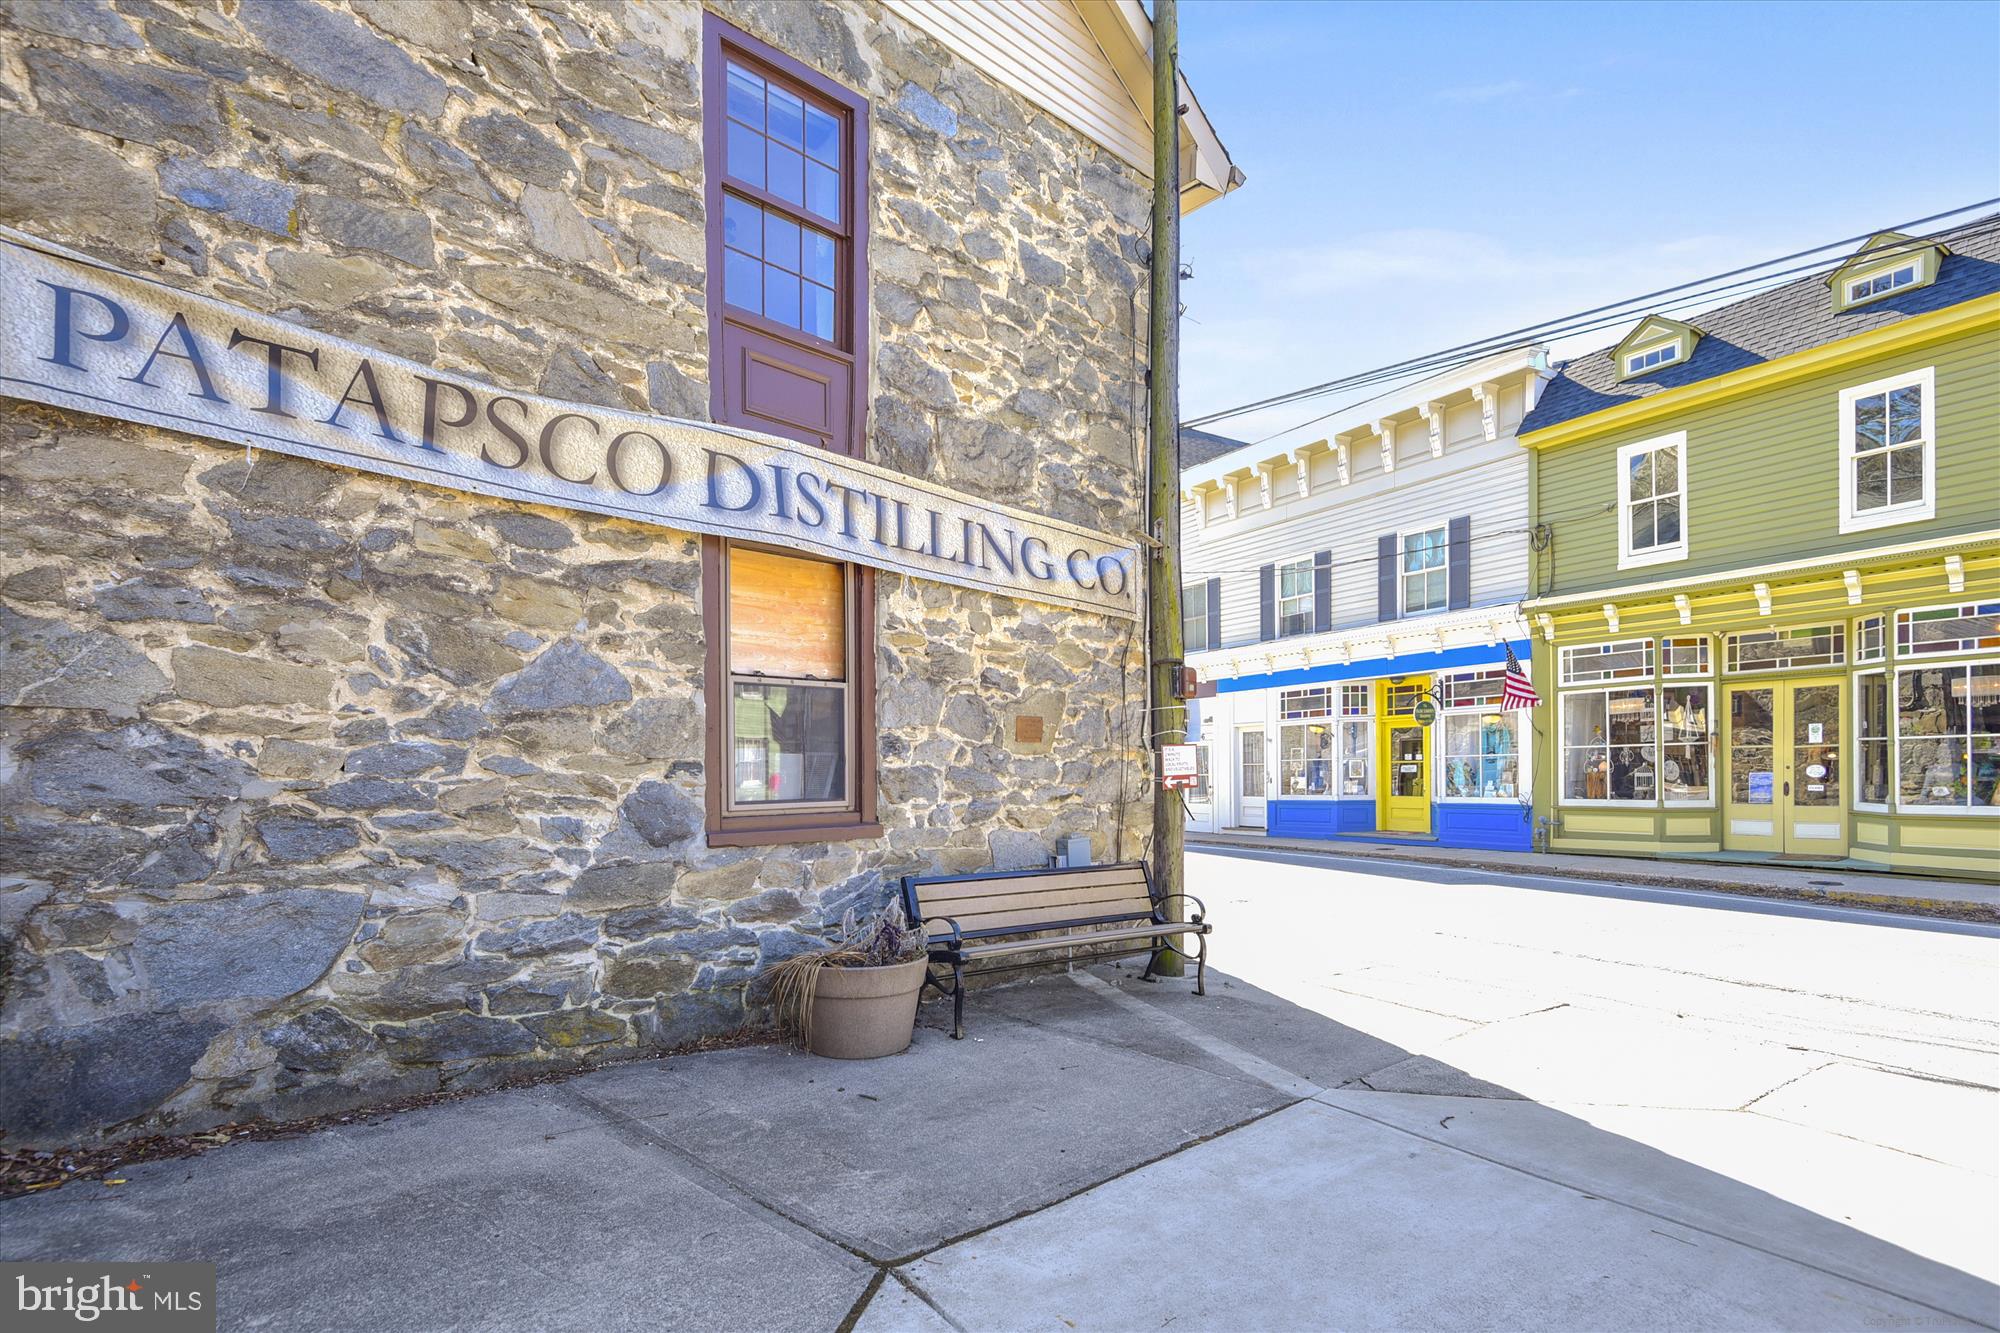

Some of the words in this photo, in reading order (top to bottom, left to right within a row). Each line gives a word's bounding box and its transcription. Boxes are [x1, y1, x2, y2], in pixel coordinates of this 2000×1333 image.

[36, 279, 672, 496] PATAPSCO
[700, 448, 1056, 581] DISTILLING
[1066, 548, 1130, 598] CO.
